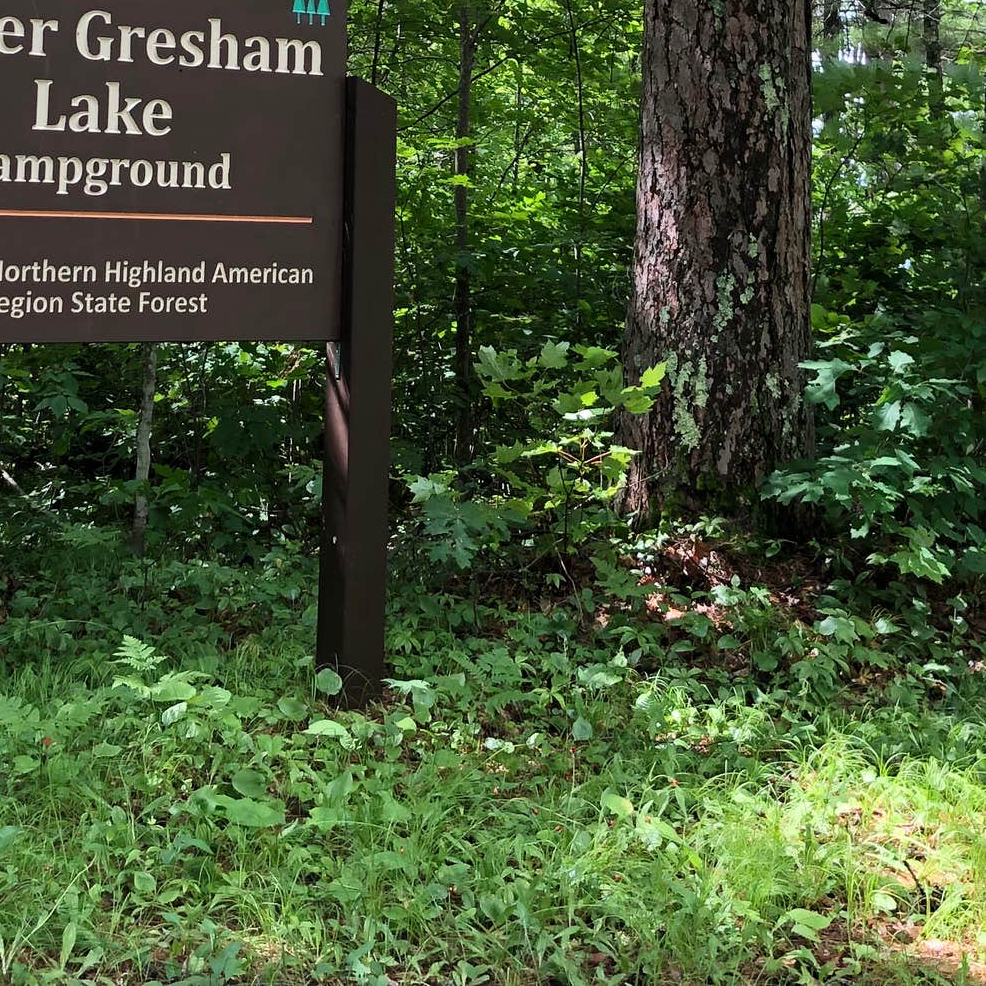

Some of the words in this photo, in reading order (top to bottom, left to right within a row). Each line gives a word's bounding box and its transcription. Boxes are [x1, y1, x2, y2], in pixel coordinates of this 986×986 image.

[75, 10, 324, 77] Gresham
[31, 79, 173, 137] Lake
[104, 260, 206, 288] Highland
[211, 262, 314, 284] American
[70, 291, 131, 314] State
[138, 291, 208, 314] Forest
